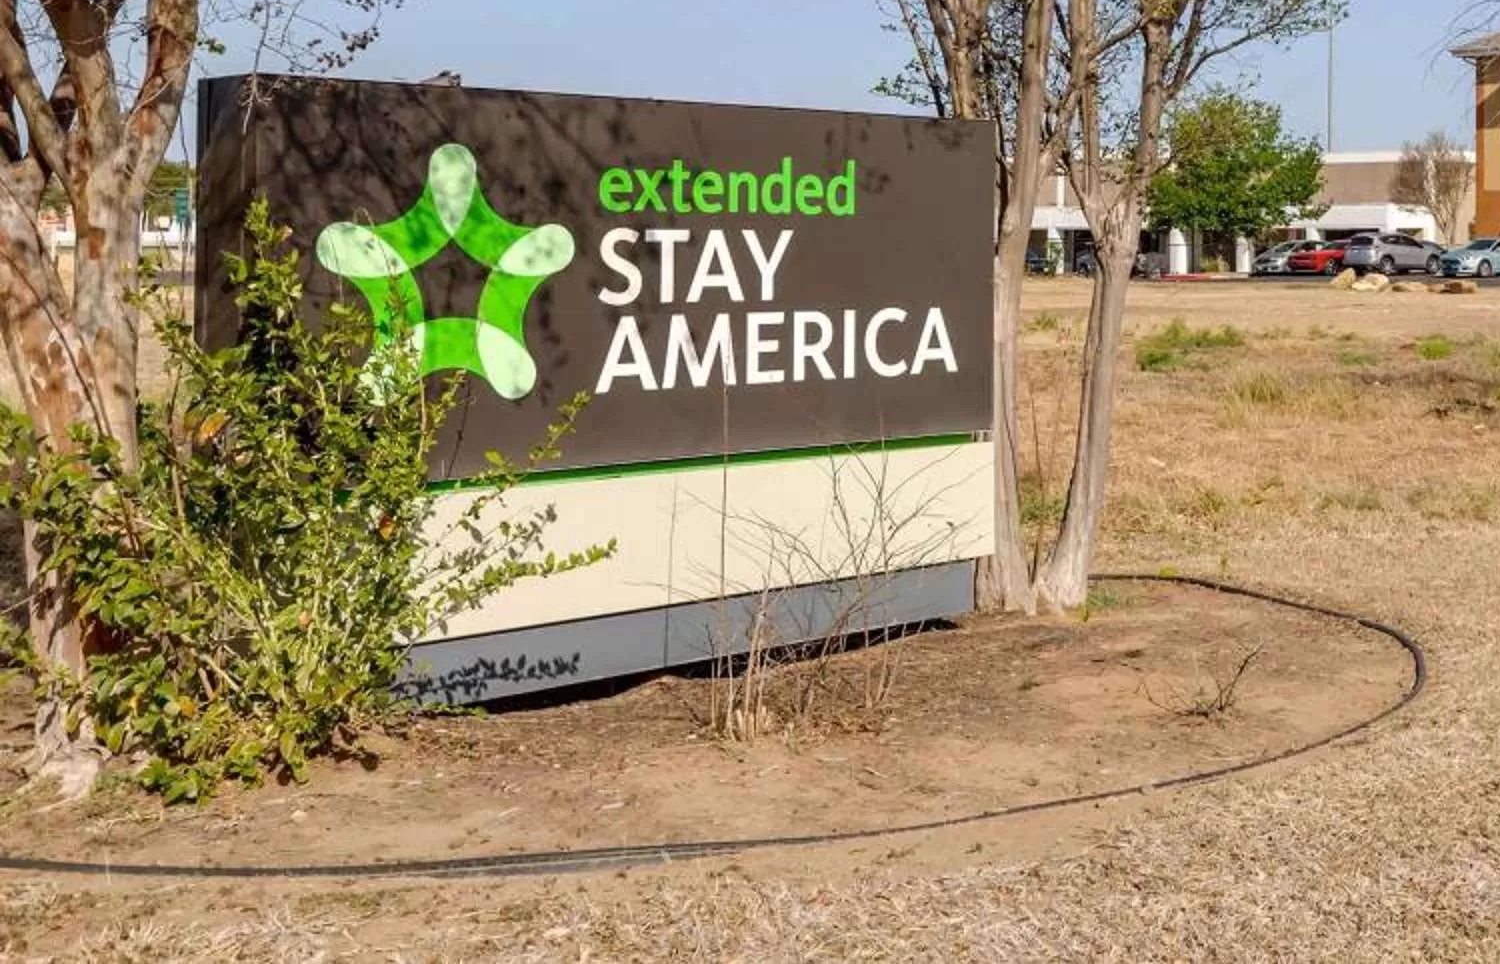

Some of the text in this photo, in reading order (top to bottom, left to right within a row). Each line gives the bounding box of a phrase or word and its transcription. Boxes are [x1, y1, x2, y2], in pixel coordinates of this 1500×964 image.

[599, 156, 856, 216] extended
[598, 227, 794, 306] STAY
[595, 306, 959, 395] AMERICA
